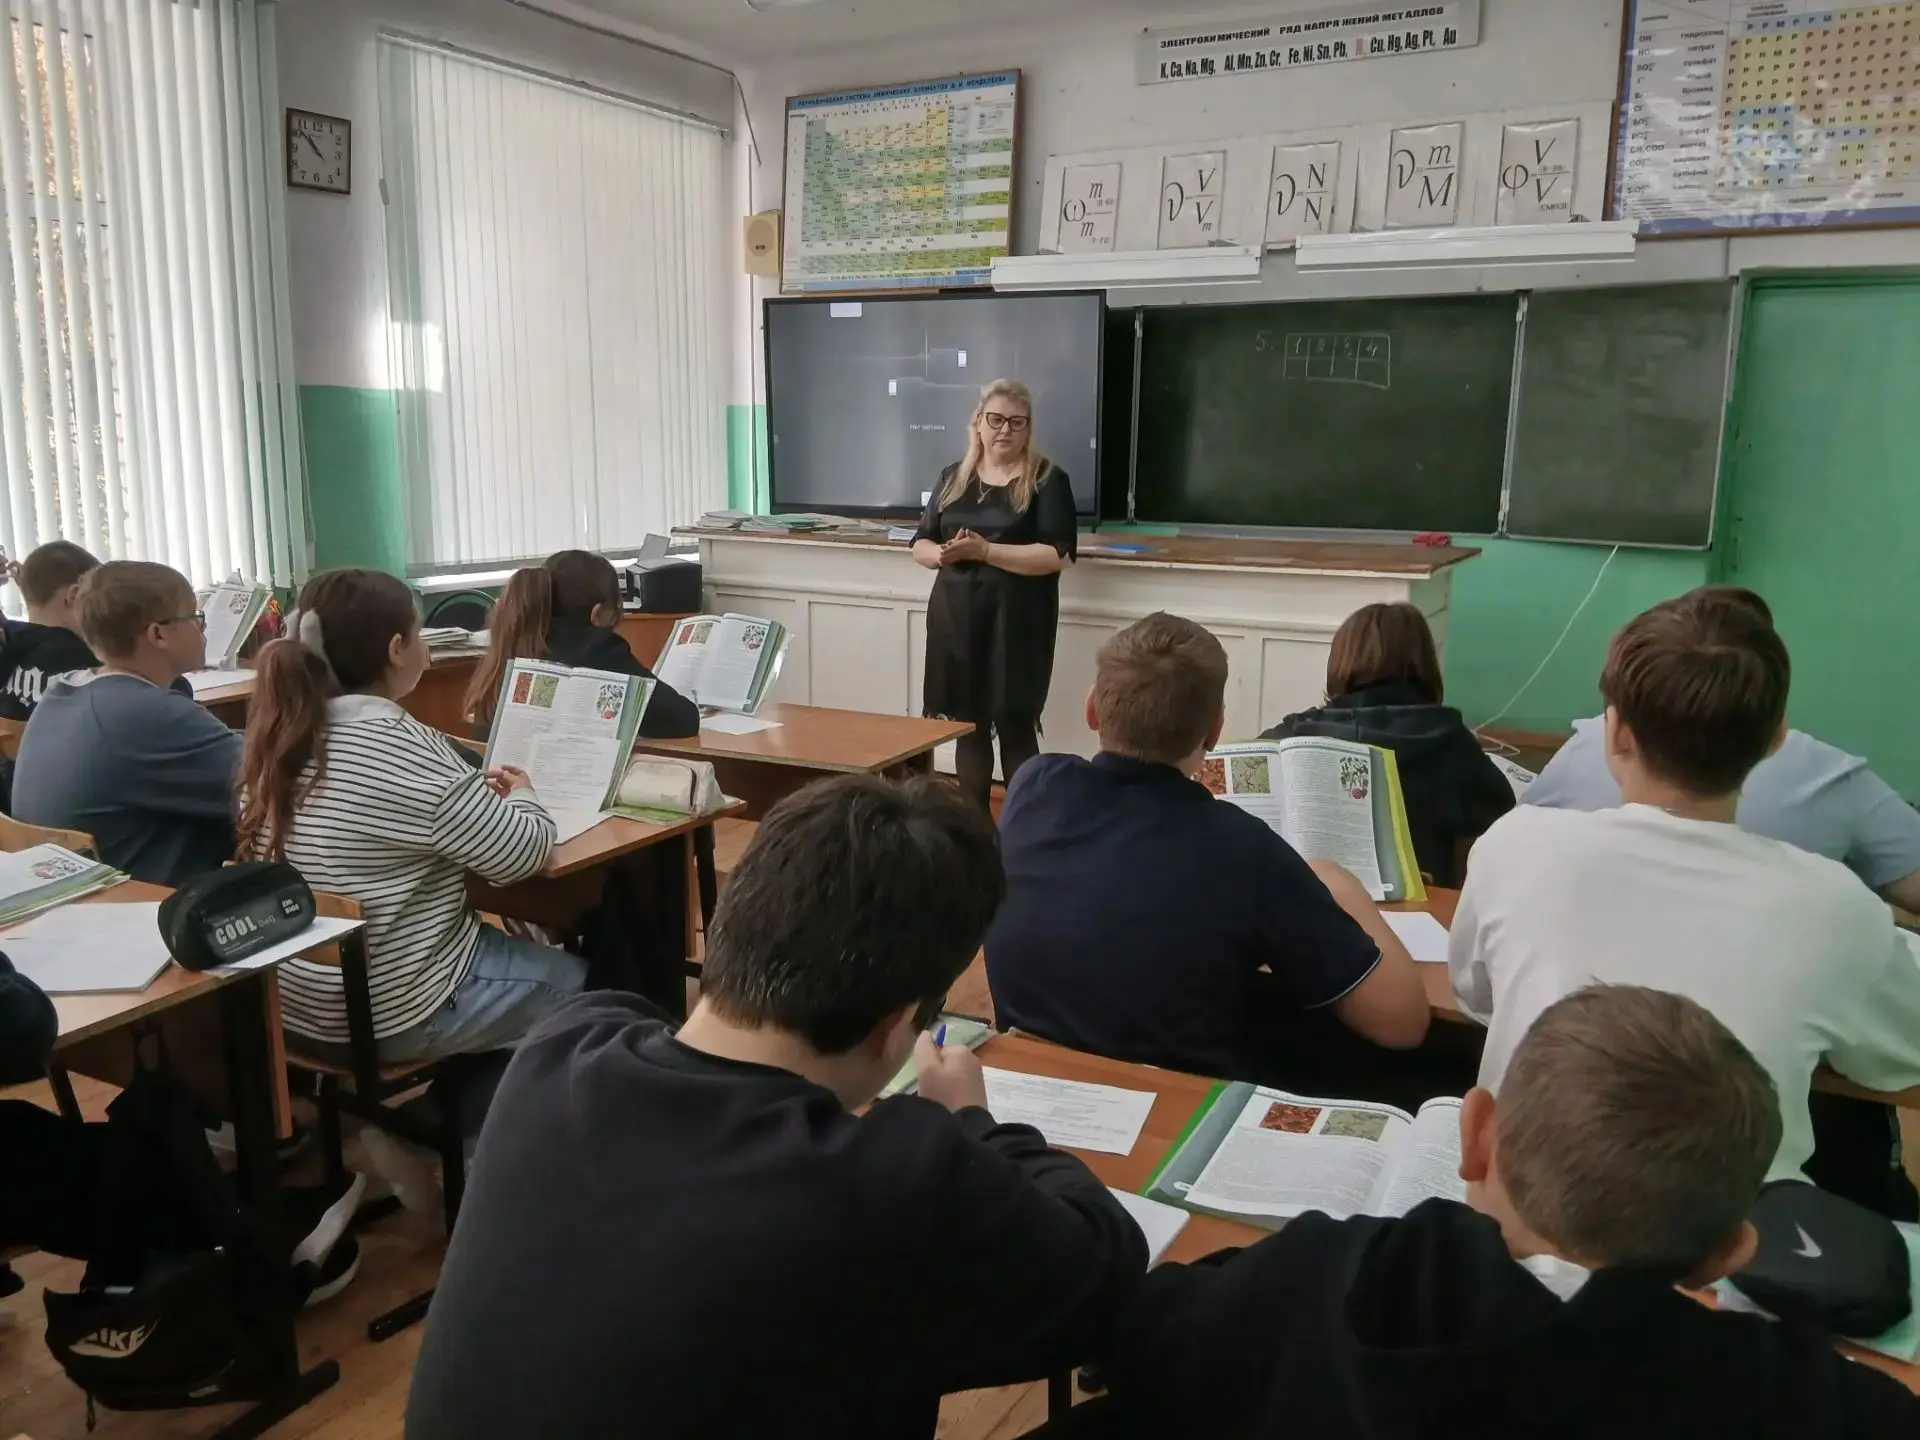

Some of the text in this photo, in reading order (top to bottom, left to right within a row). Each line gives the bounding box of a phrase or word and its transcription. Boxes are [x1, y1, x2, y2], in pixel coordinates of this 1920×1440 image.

[1160, 27, 1270, 48] ЭЛЕКТРОХИМИЧЕСКИЙ
[1279, 24, 1301, 35] РЯД
[1443, 27, 1457, 45] Au
[313, 120, 323, 132] 12
[215, 915, 258, 945] COOL
